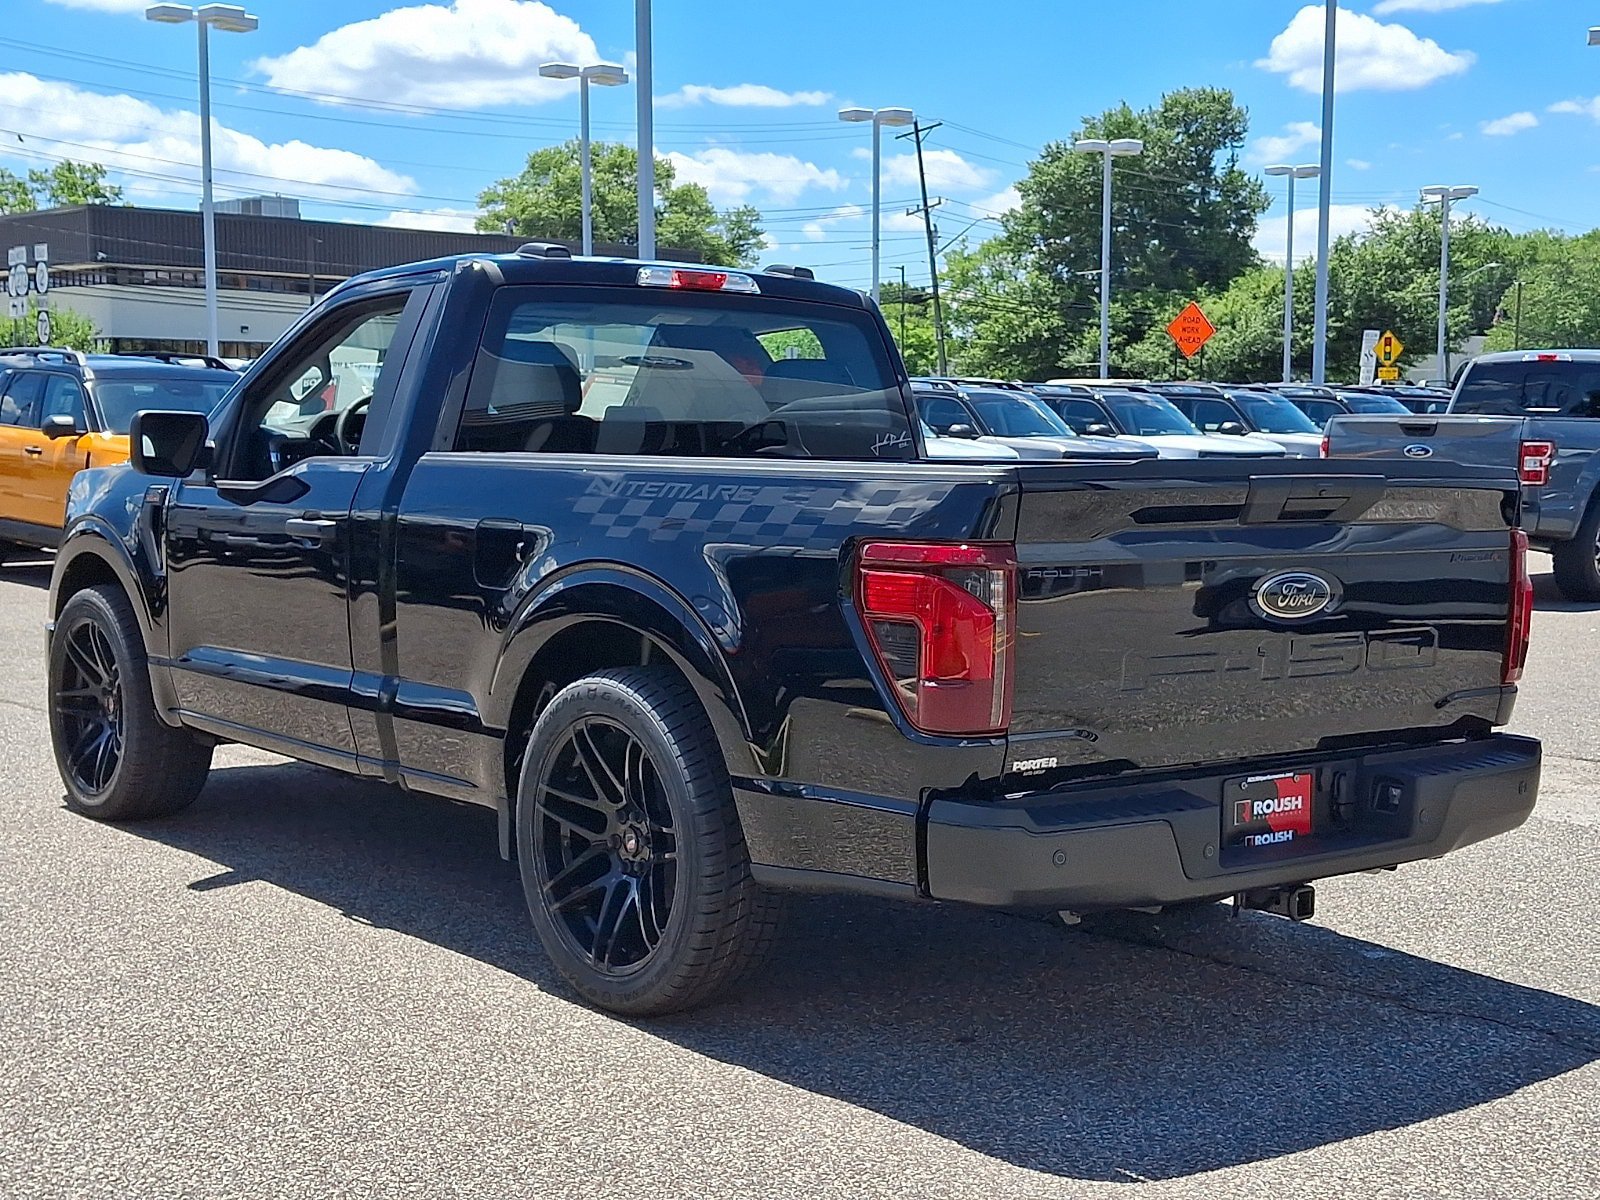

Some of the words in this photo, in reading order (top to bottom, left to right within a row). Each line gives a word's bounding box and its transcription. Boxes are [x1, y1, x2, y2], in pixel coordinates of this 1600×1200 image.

[1182, 316, 1201, 324] ROAD
[1181, 326, 1200, 334] WORK
[1178, 336, 1201, 344] AHEAD
[585, 477, 761, 501] NITEMARE
[1028, 569, 1104, 578] ROUSH
[1277, 582, 1316, 608] Ford
[1012, 757, 1058, 772] PORTER
[1253, 795, 1303, 816] ROUSH
[1254, 829, 1294, 847] ROUSH
